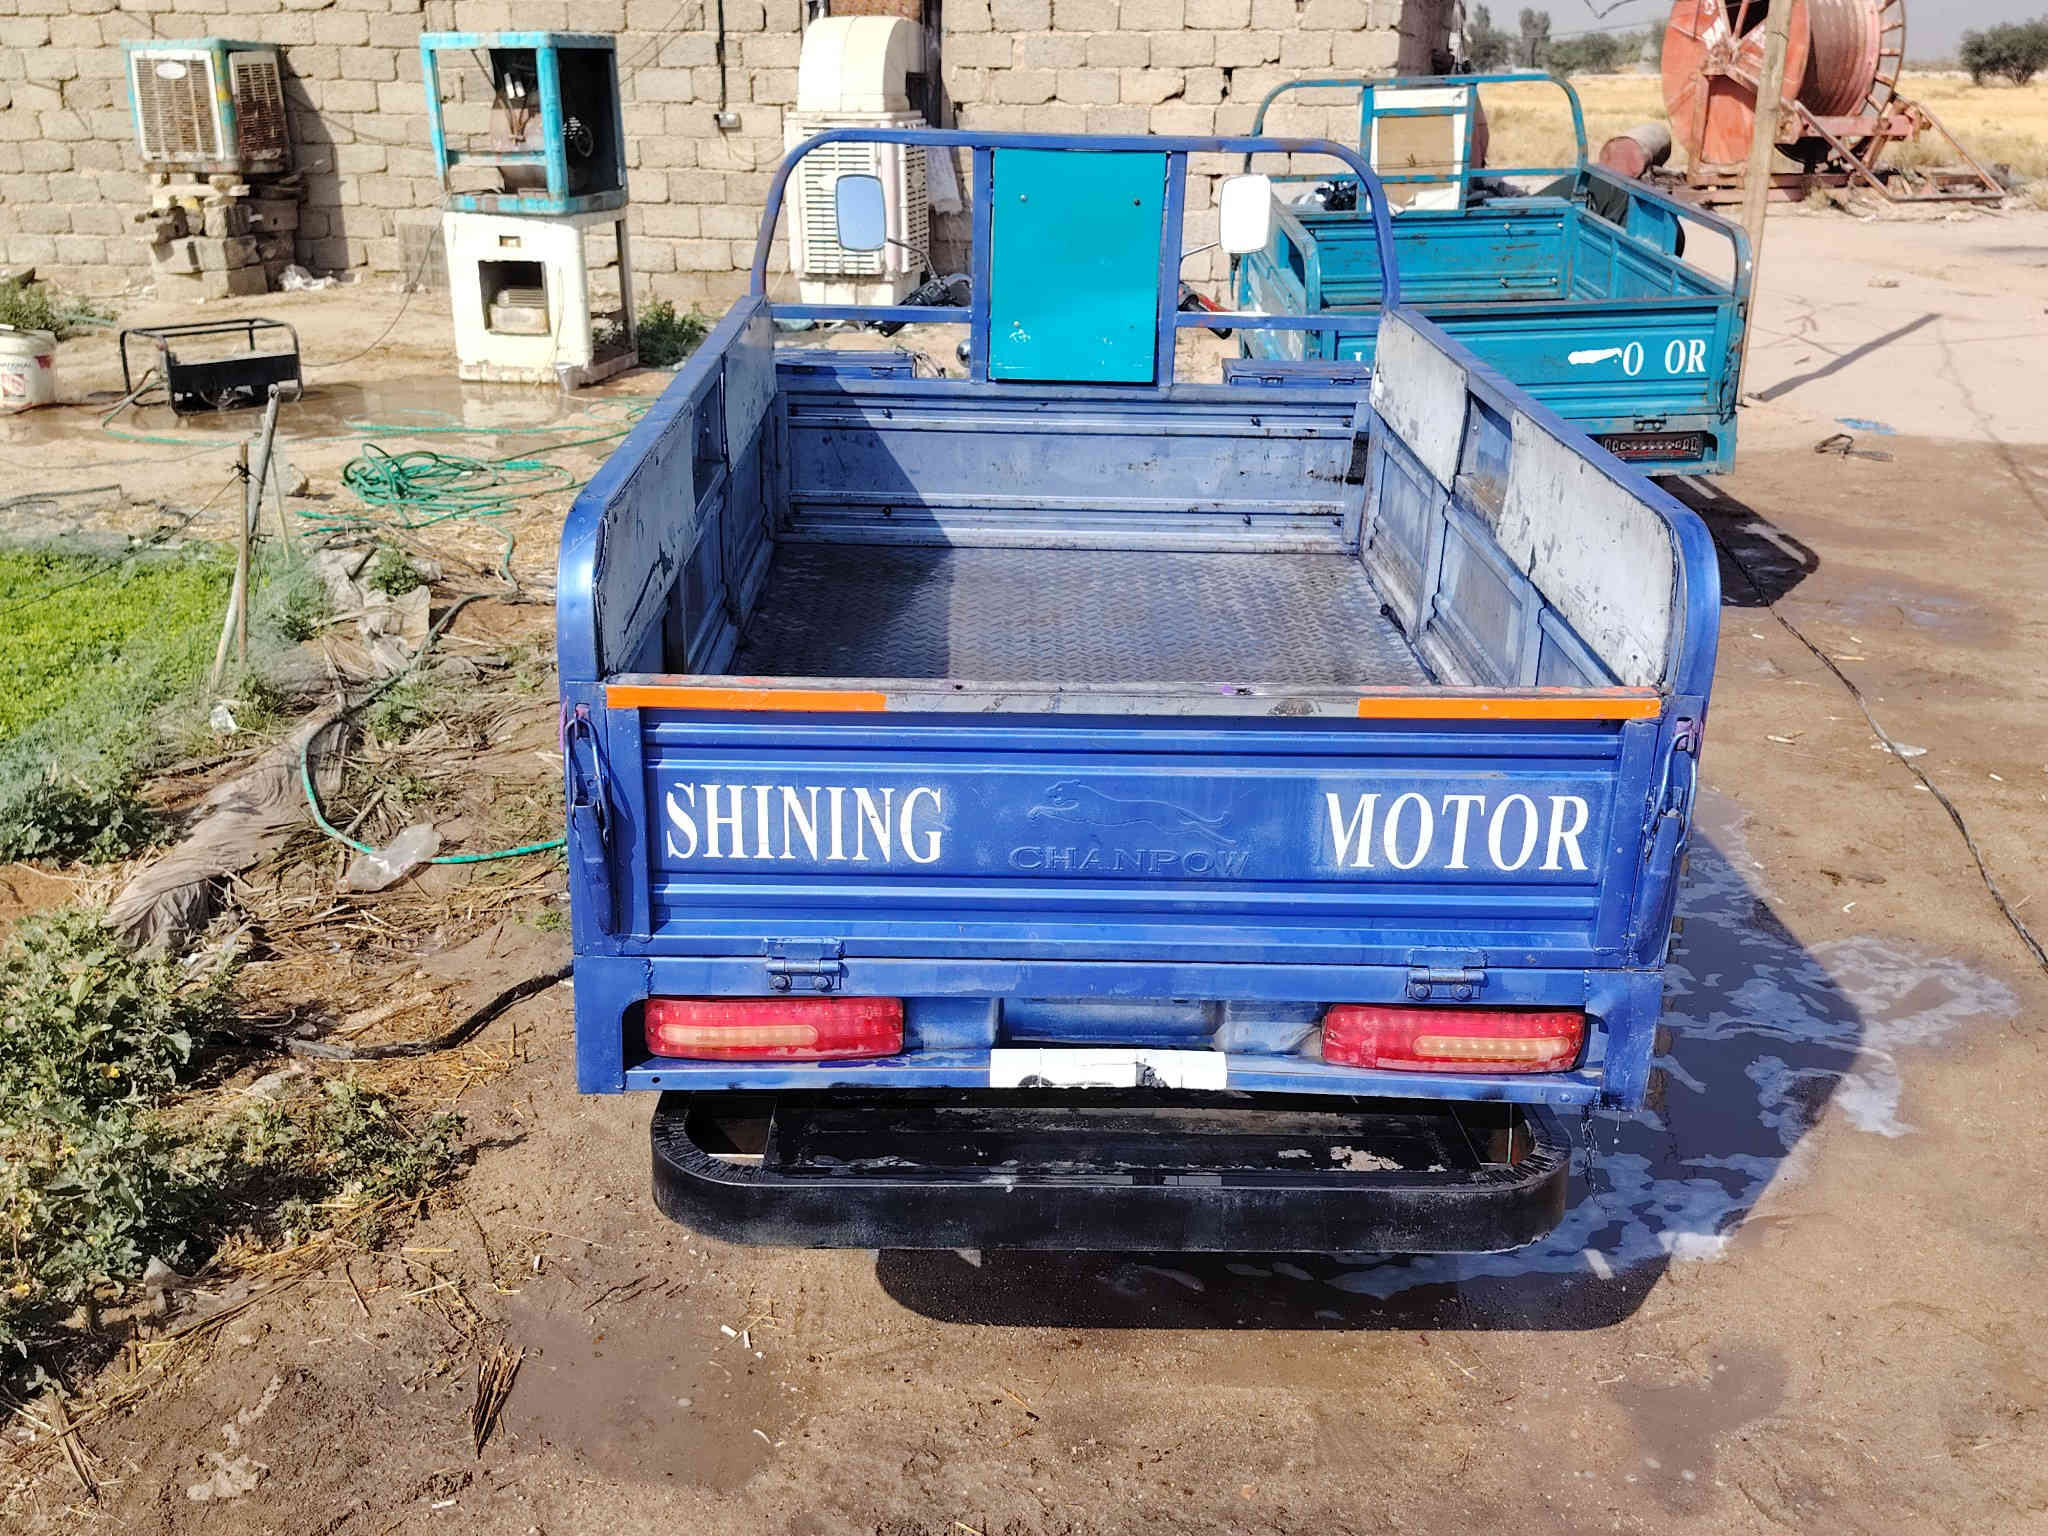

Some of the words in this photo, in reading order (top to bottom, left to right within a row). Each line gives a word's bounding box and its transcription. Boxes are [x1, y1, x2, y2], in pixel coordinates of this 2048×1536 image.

[665, 782, 943, 864] SHINING
[1325, 791, 1590, 872] MOTOR
[1007, 845, 1251, 877] CHANPOW
